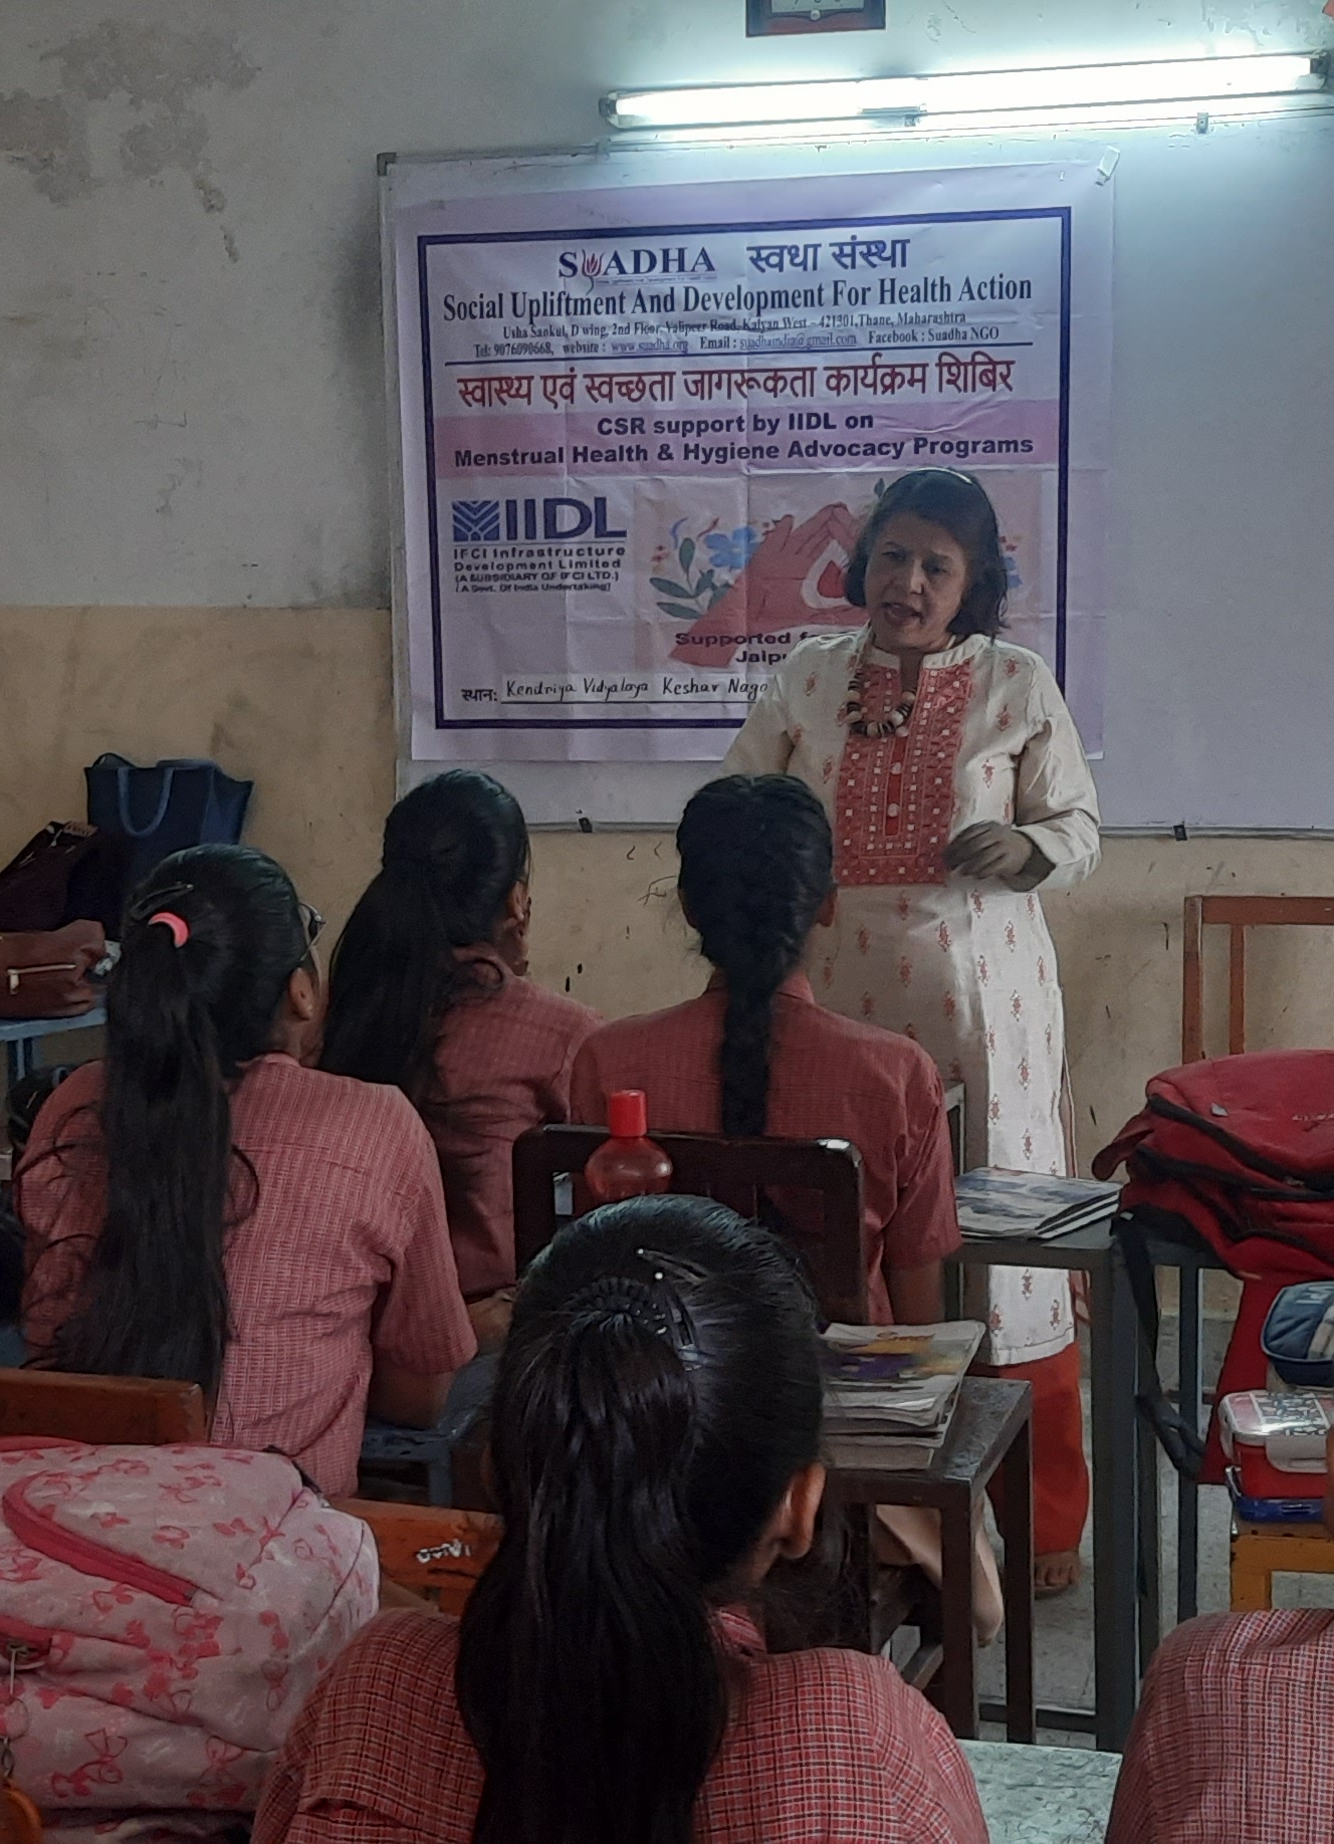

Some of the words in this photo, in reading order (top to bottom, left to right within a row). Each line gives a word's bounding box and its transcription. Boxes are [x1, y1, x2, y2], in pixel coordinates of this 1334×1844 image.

[746, 242, 822, 273] स्वधा
[829, 234, 911, 270] संस्था
[443, 292, 504, 321] Social
[510, 288, 626, 325] Upliftment
[631, 286, 676, 315] And
[683, 282, 825, 317] Development
[832, 279, 872, 307] For
[878, 275, 952, 305] Health
[958, 272, 1033, 302] Action
[503, 326, 528, 339] Usha
[571, 323, 580, 337] D
[582, 324, 609, 339] wing,
[611, 322, 631, 335] 2nd
[743, 318, 779, 333] Kalyan
[782, 316, 808, 329] West
[897, 310, 966, 326] Maharashtra
[700, 336, 730, 350] Email
[868, 328, 919, 344] Facebook
[927, 327, 968, 342] Suadha
[970, 326, 1000, 341] NGO
[456, 375, 535, 408] स्वास्थ्य
[540, 366, 578, 409] एवं
[583, 370, 677, 405] स्वच्छता
[682, 366, 818, 402] जागरूकता
[823, 351, 929, 396] कार्यक्रम
[935, 350, 1016, 393] शिबिर
[597, 416, 646, 436] CSR
[653, 414, 746, 438] support
[753, 413, 780, 436] by
[788, 412, 837, 431] IIDL
[845, 414, 874, 430] on
[455, 446, 564, 468] Menstrual
[572, 444, 649, 465] Health
[657, 443, 675, 462] &
[683, 441, 780, 466] Hygiene
[787, 439, 906, 460] Advocacy
[914, 437, 1034, 459] Programs
[505, 496, 628, 541] IIDL
[454, 547, 487, 560] IFCI
[493, 546, 626, 559] Infrastructure
[454, 560, 553, 573] Development
[558, 558, 621, 570] Limited
[675, 632, 791, 648] Supported
[506, 679, 577, 702] Kendriya
